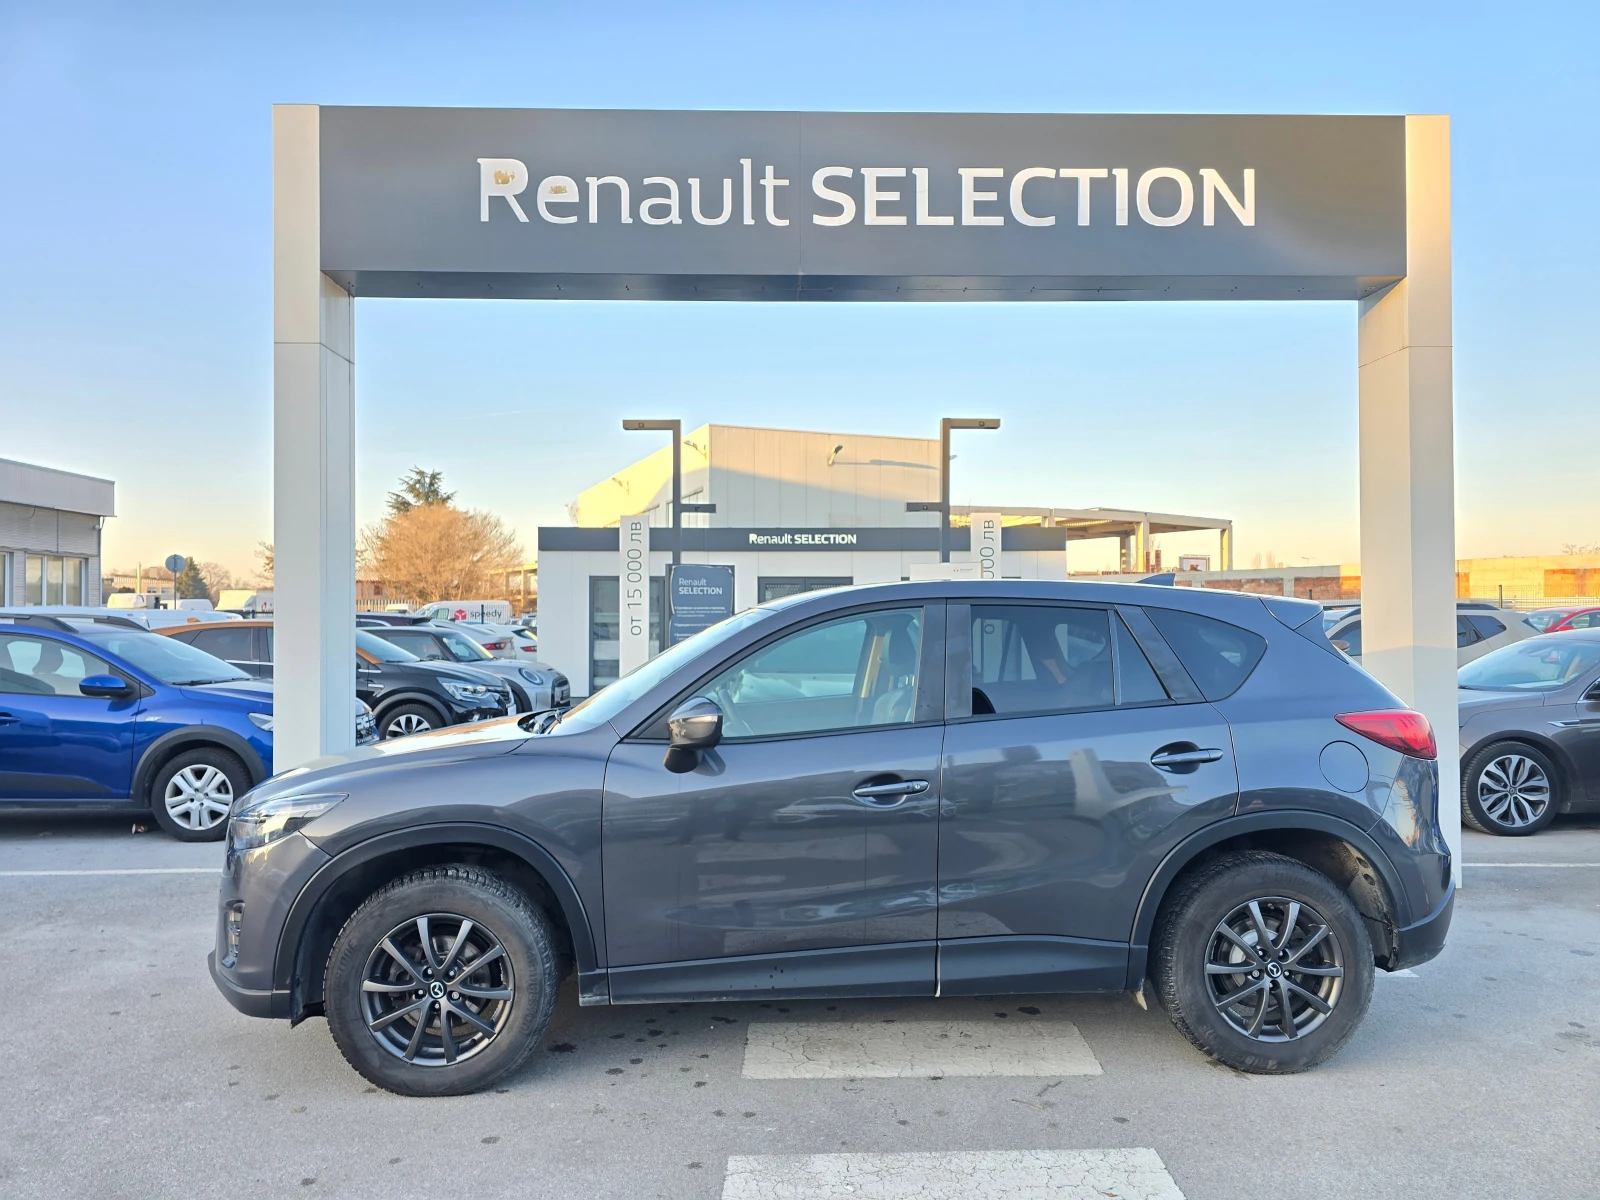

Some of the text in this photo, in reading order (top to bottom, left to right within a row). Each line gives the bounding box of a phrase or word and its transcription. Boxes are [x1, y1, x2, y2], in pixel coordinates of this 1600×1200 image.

[477, 158, 1256, 227] Renault SELECTION
[749, 533, 857, 545] Renault SELECTION
[627, 548, 642, 583] 000
[678, 578, 707, 586] Renault
[627, 589, 642, 609] 15
[678, 587, 723, 595] SELECTION
